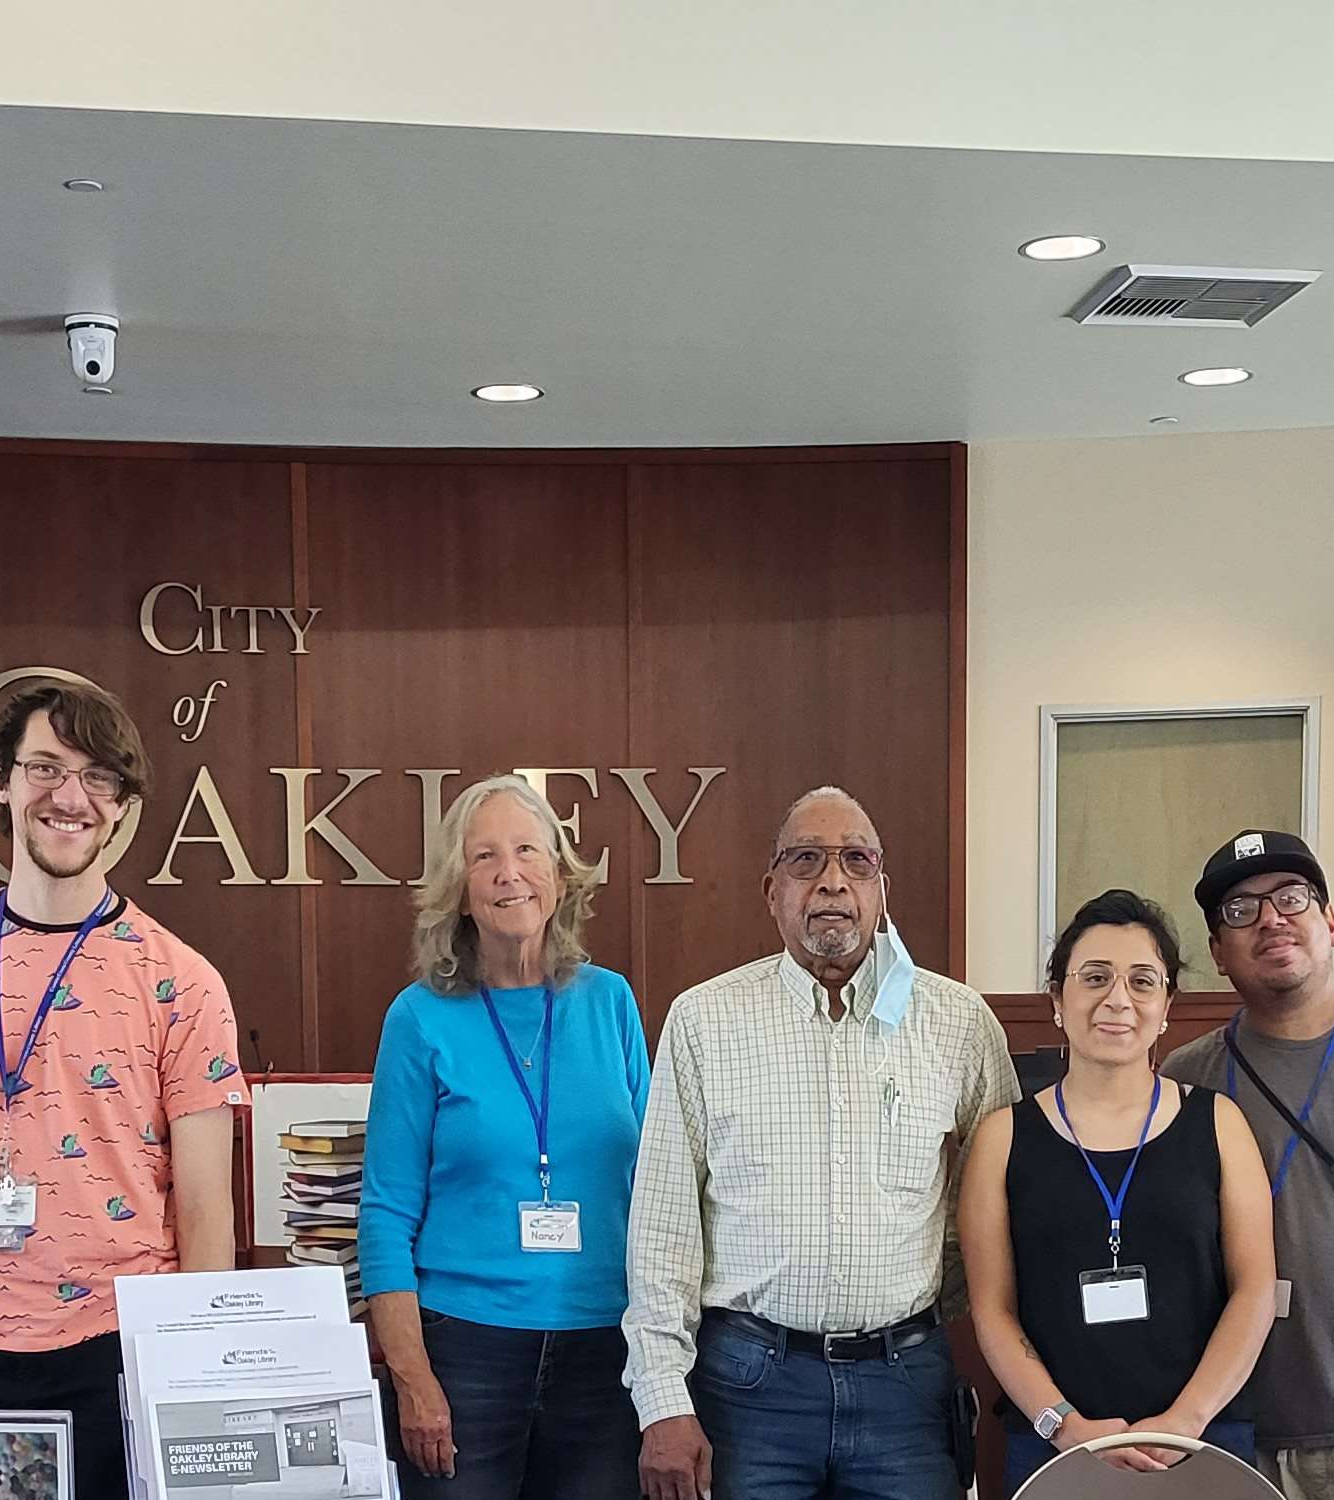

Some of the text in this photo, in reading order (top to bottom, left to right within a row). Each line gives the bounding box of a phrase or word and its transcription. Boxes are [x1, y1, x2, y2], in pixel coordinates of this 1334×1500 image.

[172, 679, 227, 743] of
[530, 1230, 565, 1243] Nancy
[168, 1441, 254, 1454] FRIENDS OF THE
[169, 1451, 259, 1464] OAKLEY LIBRARY
[170, 1462, 253, 1475] E-NEWSLETTER
